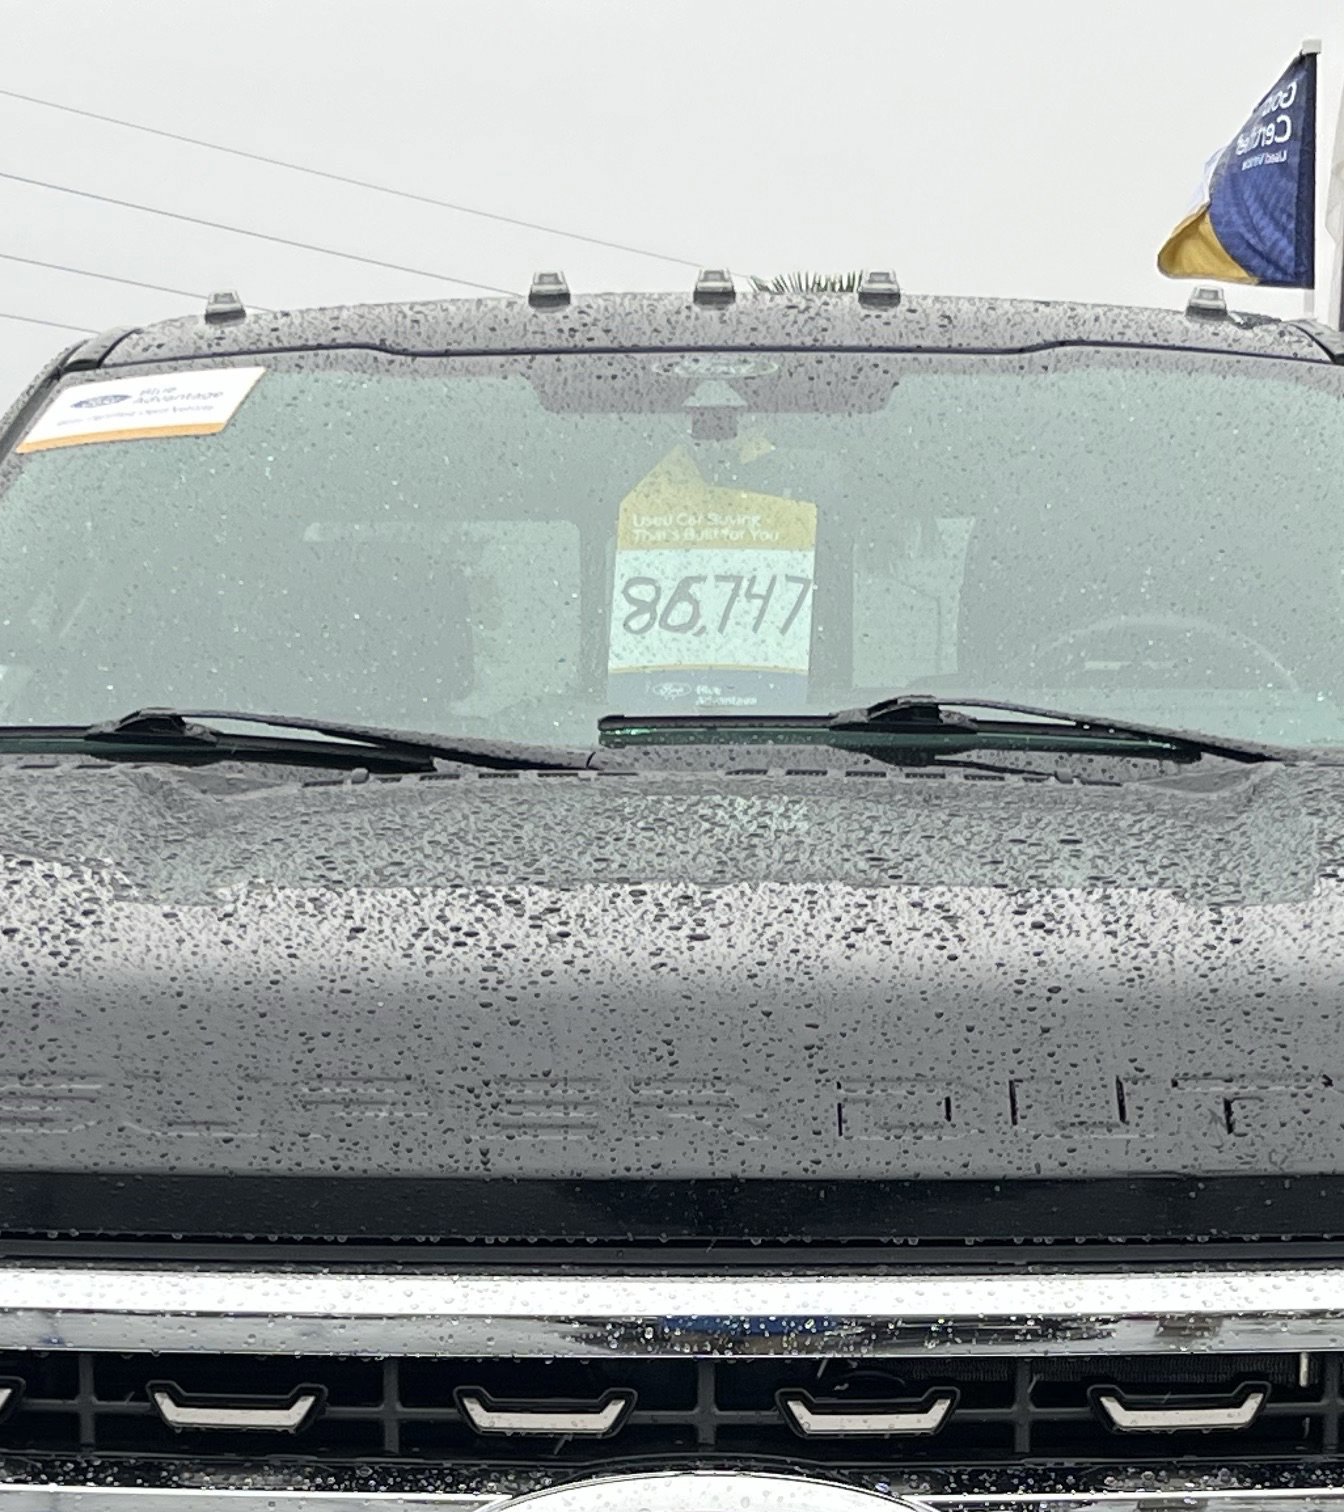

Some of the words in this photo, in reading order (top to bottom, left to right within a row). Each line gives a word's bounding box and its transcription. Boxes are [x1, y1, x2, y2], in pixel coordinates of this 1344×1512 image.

[632, 512, 673, 527] Used
[676, 511, 702, 526] Car
[720, 527, 746, 541] for
[748, 528, 779, 541] You
[622, 575, 812, 636] 86,747
